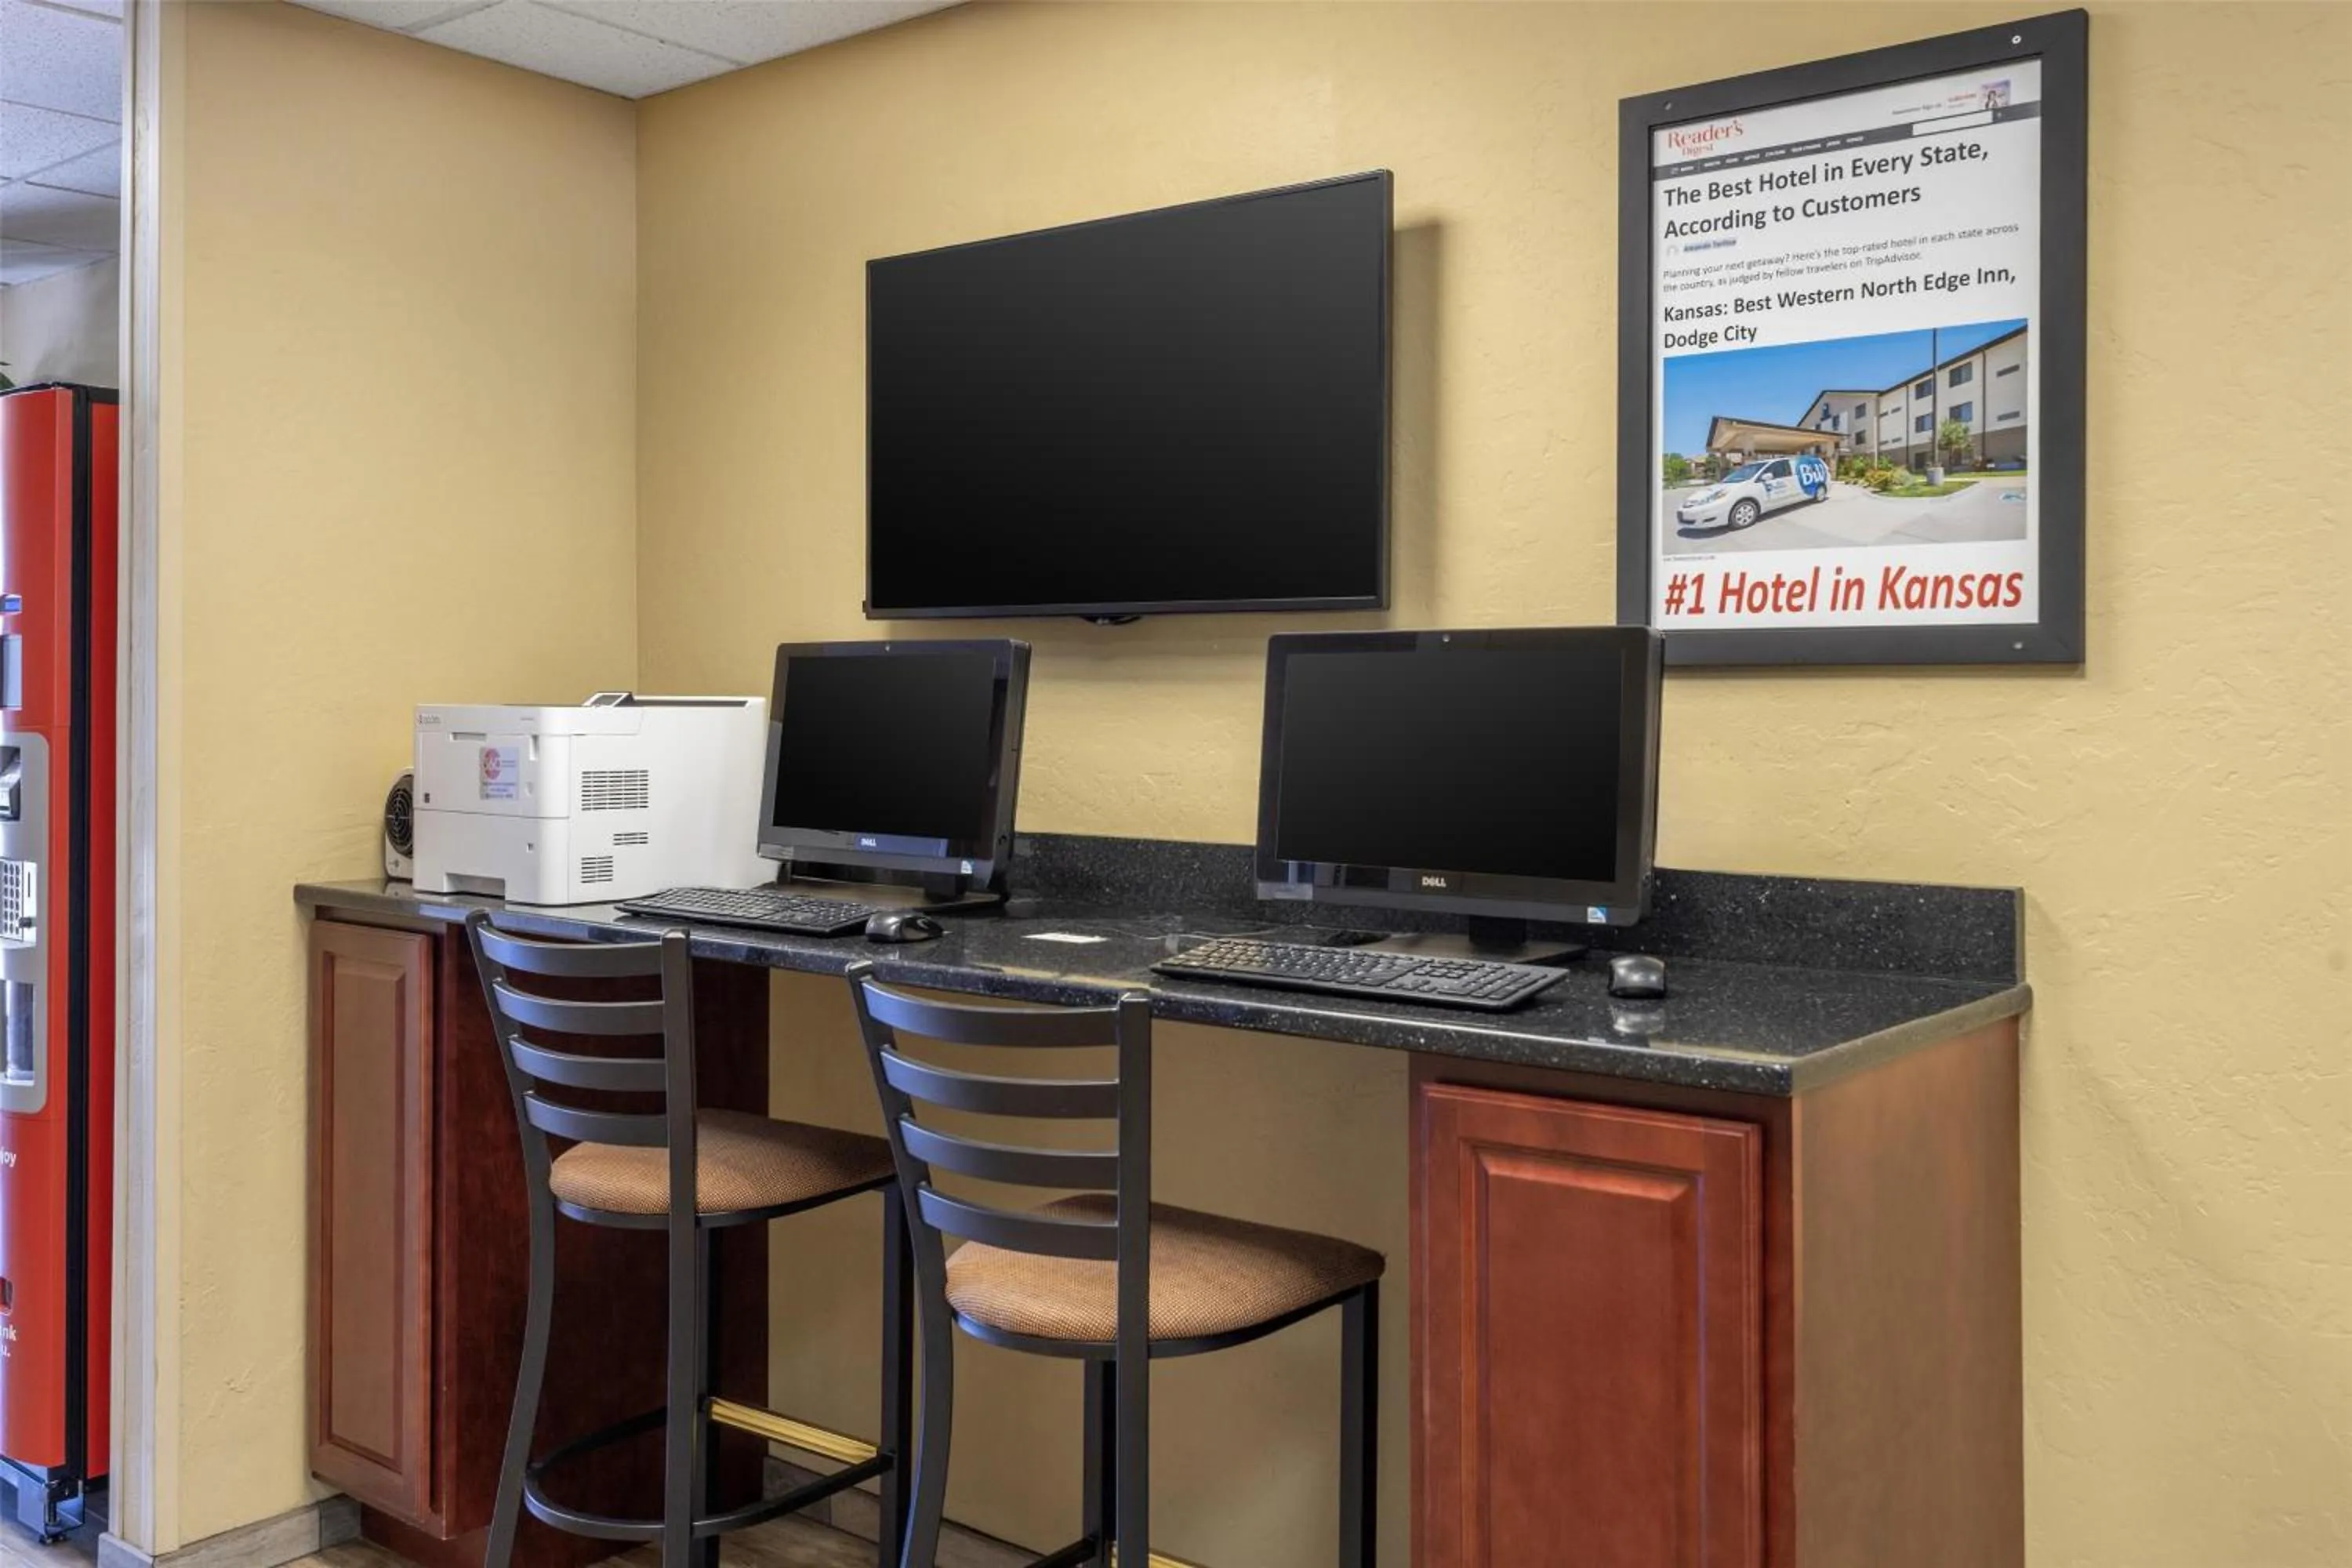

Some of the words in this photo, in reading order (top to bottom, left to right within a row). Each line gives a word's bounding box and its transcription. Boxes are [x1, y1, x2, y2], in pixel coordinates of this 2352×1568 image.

[1668, 119, 1744, 148] Reader's
[1664, 187, 1700, 206] The
[1708, 178, 1752, 201] Best
[1759, 165, 1816, 191] Hotel
[1824, 163, 1843, 182] in
[1852, 154, 1913, 178] Every
[1920, 142, 1988, 167] State,
[1664, 210, 1766, 238] According
[1773, 205, 1795, 223] to
[1802, 187, 1921, 218] Customers
[1664, 267, 1700, 279] Planning
[1702, 264, 1723, 275] your
[1725, 261, 1744, 270] next
[1746, 253, 1791, 270] getaway?
[1792, 249, 1821, 261] Here's
[1824, 246, 1839, 256] the
[1842, 240, 1888, 256] top-rated
[1890, 238, 1916, 249] hotel
[1918, 236, 1928, 245] in
[1931, 232, 1955, 243] each
[1958, 229, 1983, 239] state
[1986, 223, 2020, 235] across
[1664, 282, 1677, 292] the
[1729, 271, 1760, 286] judged
[1762, 270, 1773, 281] by
[1776, 267, 1803, 278] fellow
[1806, 262, 1847, 275] travelers
[1849, 260, 1862, 269] on
[1664, 303, 1728, 322] Kansas:
[1734, 296, 1772, 314] Best
[1777, 287, 1854, 309] Western
[1861, 276, 1917, 299] North
[1923, 272, 1970, 292] Edge
[1977, 267, 2016, 285] Inn,
[1664, 329, 1718, 349] Dodge
[1724, 325, 1757, 343] City
[1665, 573, 1705, 615] #1
[1719, 566, 1820, 614] Hotel
[1830, 566, 1865, 611] in
[1878, 566, 2024, 611] Kansas
[1421, 876, 1446, 887] DELL
